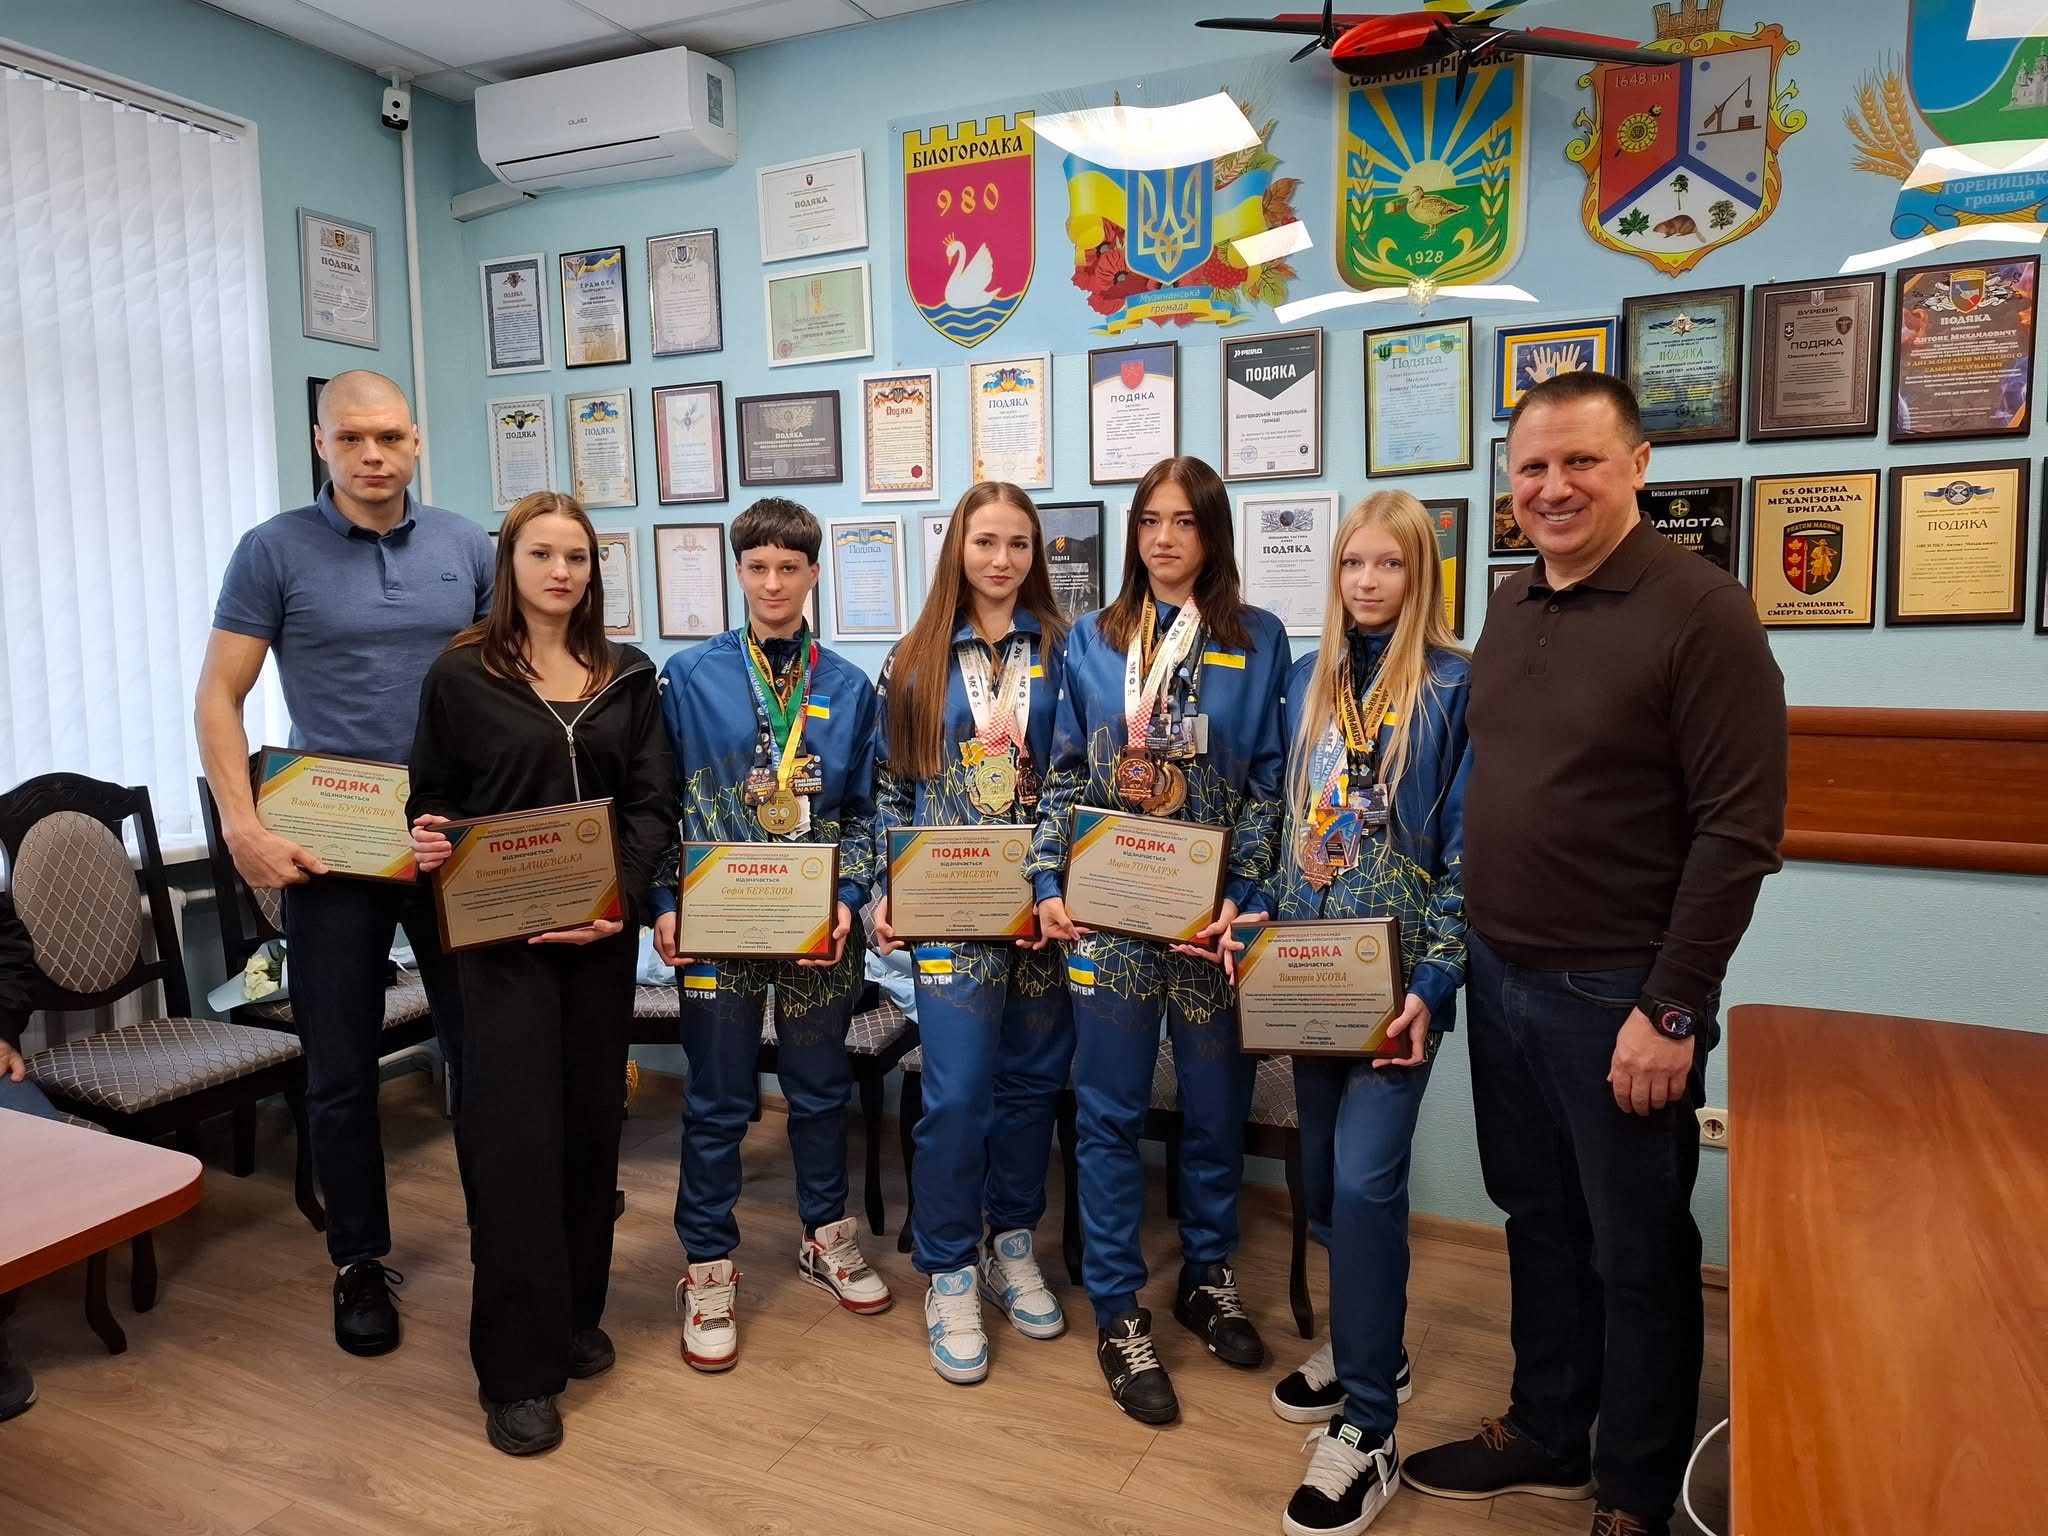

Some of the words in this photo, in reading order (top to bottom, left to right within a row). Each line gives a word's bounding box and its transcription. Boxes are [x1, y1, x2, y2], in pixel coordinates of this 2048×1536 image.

[1616, 72, 1647, 88] 1648
[913, 136, 1023, 168] БІЛОГОРОДКА
[795, 196, 828, 208] ПОДЯКА
[1965, 190, 2035, 209] громада
[1405, 249, 1443, 267] 1928
[321, 257, 360, 273] ПОДЯКА
[1151, 302, 1188, 313] громада
[1940, 314, 1991, 326] ПОДЯКА
[1791, 338, 1843, 350] ПОДЯКА
[1392, 355, 1442, 369] Подяка
[1246, 364, 1296, 382] ПОДЯКА
[988, 398, 1029, 408] ПОДЯКА
[1110, 391, 1155, 403] ПОДЯКА
[505, 431, 537, 439] ПОДЯКА
[585, 427, 616, 436] ПОДЯКА
[1782, 488, 1795, 496] 65
[1798, 486, 1848, 495] ОКРЕМА
[1787, 504, 1841, 513] БРИГАДА
[1651, 517, 1724, 529] АМОТА
[1928, 519, 1988, 531] ПОДЯКА
[1263, 545, 1311, 554] ПОДЯКА
[311, 775, 381, 794] ПОДЯКА
[320, 791, 370, 802] відзначається
[489, 832, 562, 853] ПОДЯКА
[1115, 836, 1176, 854] ПОДЯКА
[502, 848, 553, 860] відзначається
[932, 847, 990, 859] ПОДЯКА
[1123, 850, 1167, 861] відзначається
[727, 863, 788, 875] ПОДЯКА
[1107, 858, 1130, 869] Марія
[475, 865, 517, 879] Вікторія
[1278, 945, 1342, 960] ПОДЯКА
[1278, 972, 1314, 983] Вікторія
[1316, 972, 1347, 982] УСОВА
